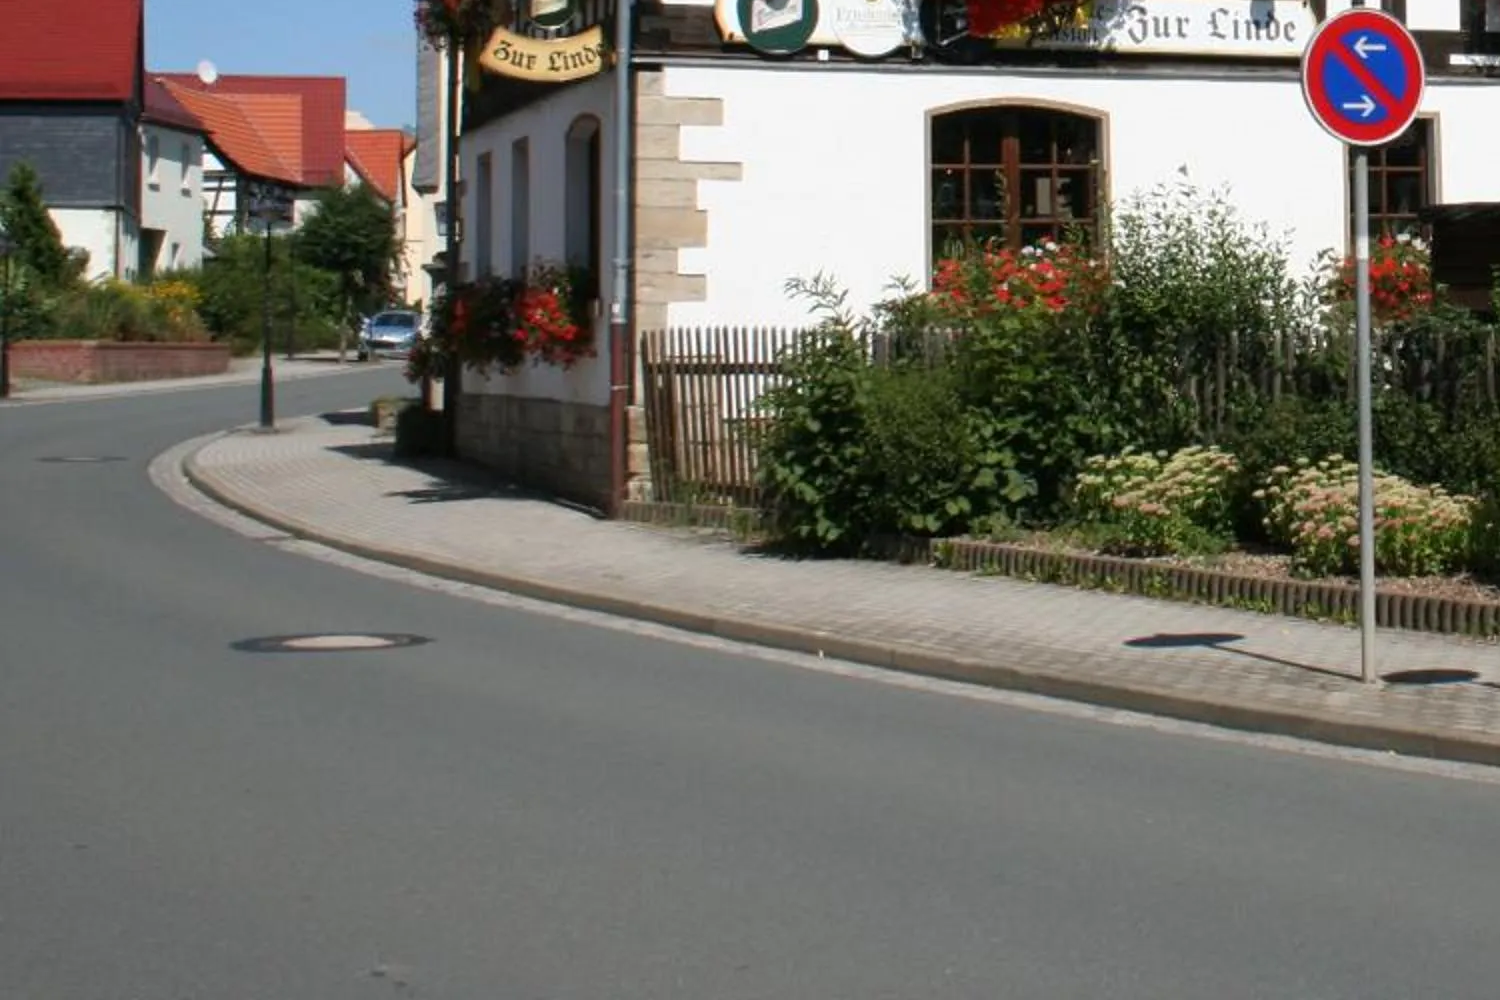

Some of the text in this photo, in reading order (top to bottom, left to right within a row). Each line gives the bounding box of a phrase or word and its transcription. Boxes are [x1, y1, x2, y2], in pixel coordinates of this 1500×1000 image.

[1128, 4, 1190, 44] Zur
[1207, 7, 1296, 42] Linde
[493, 40, 606, 72] Zur Linde
